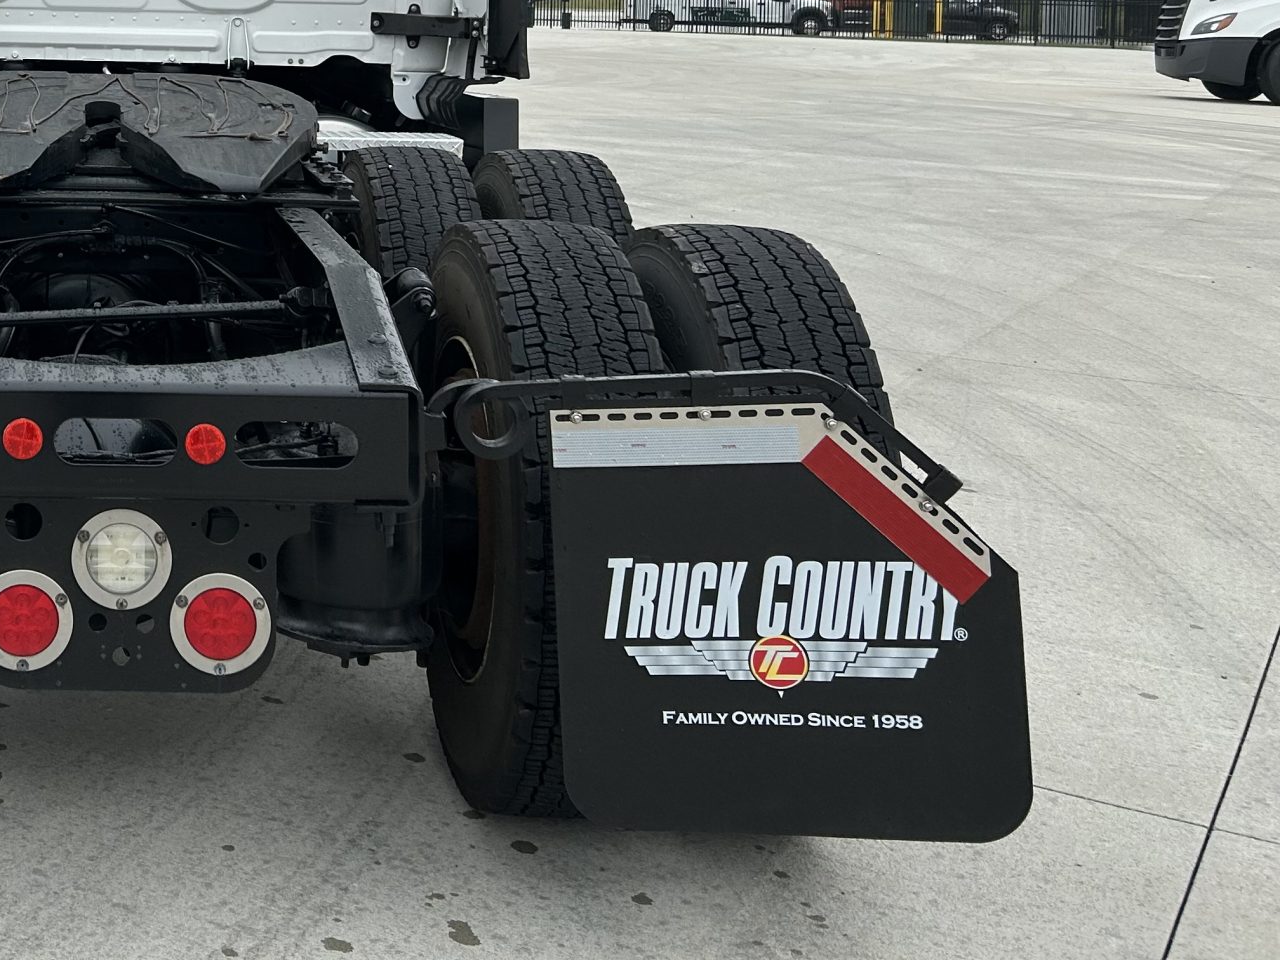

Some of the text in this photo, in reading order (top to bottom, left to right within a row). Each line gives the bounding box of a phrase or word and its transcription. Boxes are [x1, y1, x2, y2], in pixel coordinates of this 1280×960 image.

[604, 557, 748, 640] TRUCK
[753, 644, 802, 681] TC
[662, 710, 923, 730] FAMILY OWNED SINCE 1958
